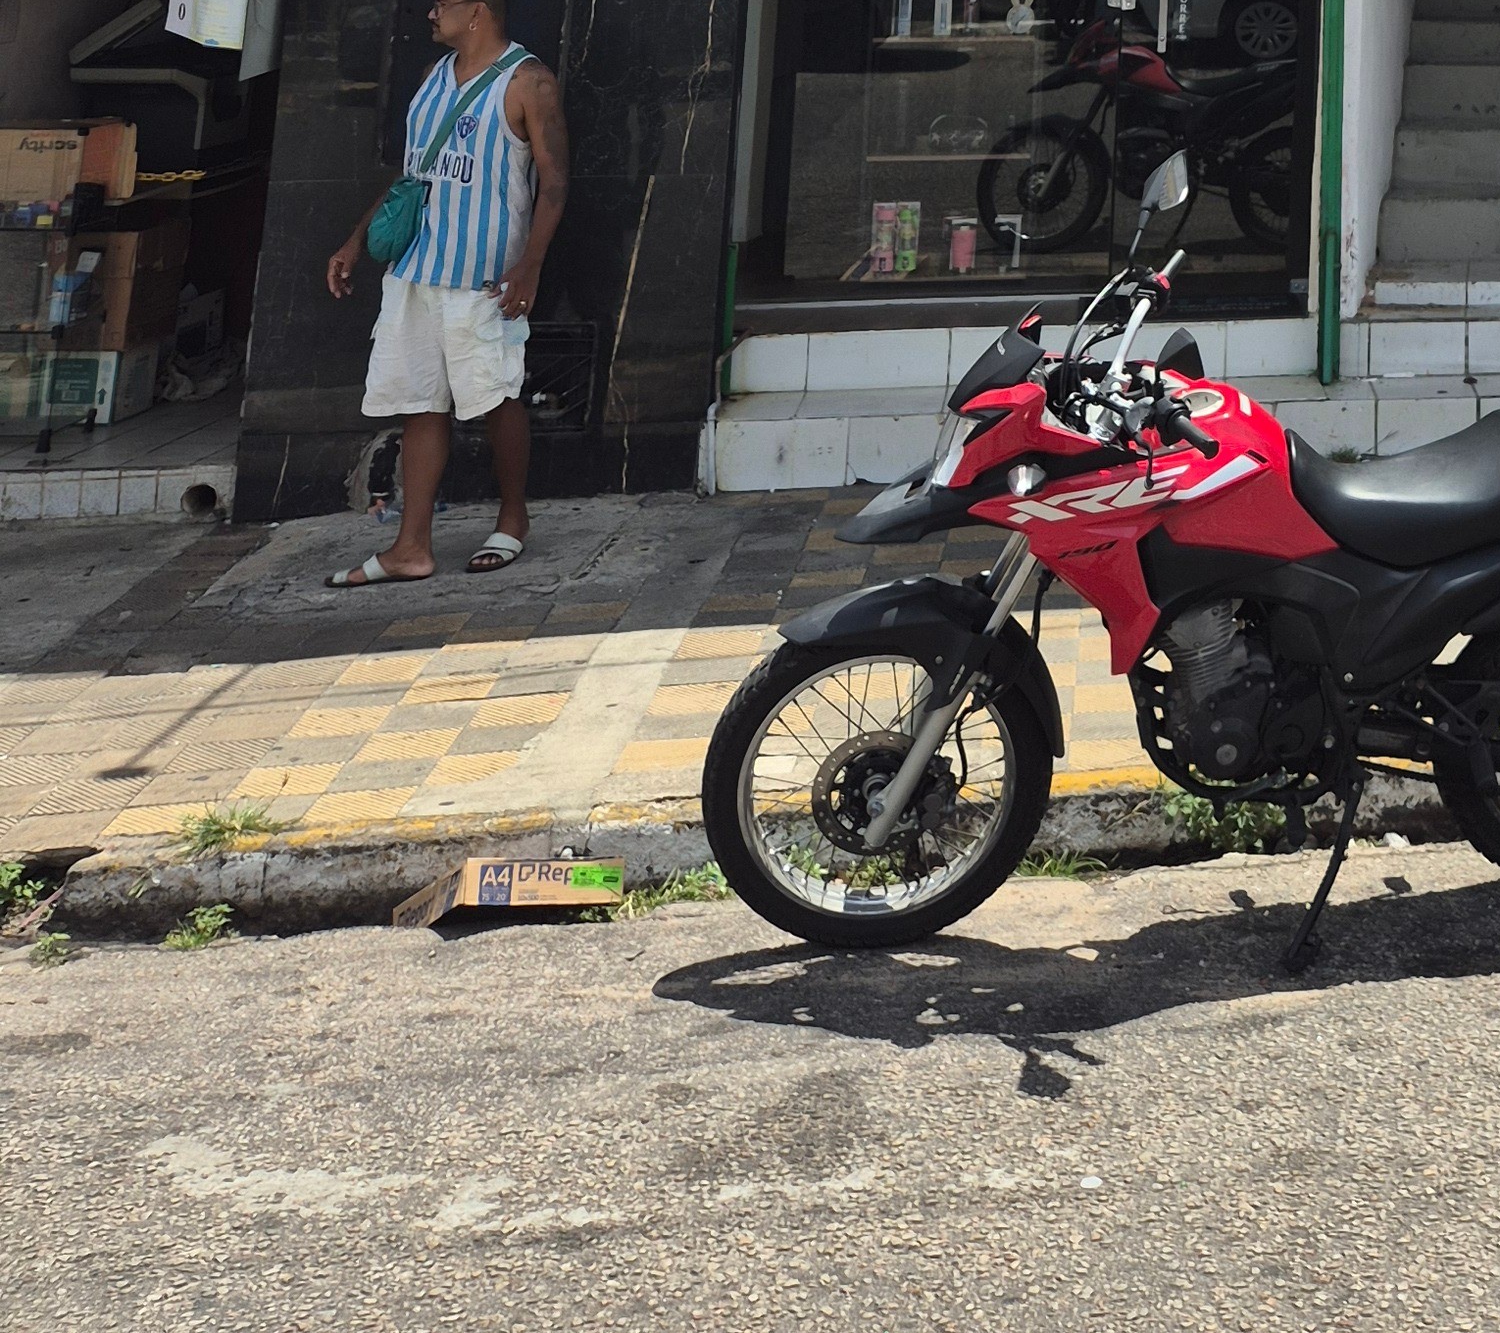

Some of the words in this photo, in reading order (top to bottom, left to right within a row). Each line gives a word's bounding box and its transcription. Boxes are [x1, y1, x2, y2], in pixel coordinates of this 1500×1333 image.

[1006, 463, 1191, 525] XRE
[1057, 539, 1119, 559] 190
[482, 865, 511, 887] A4
